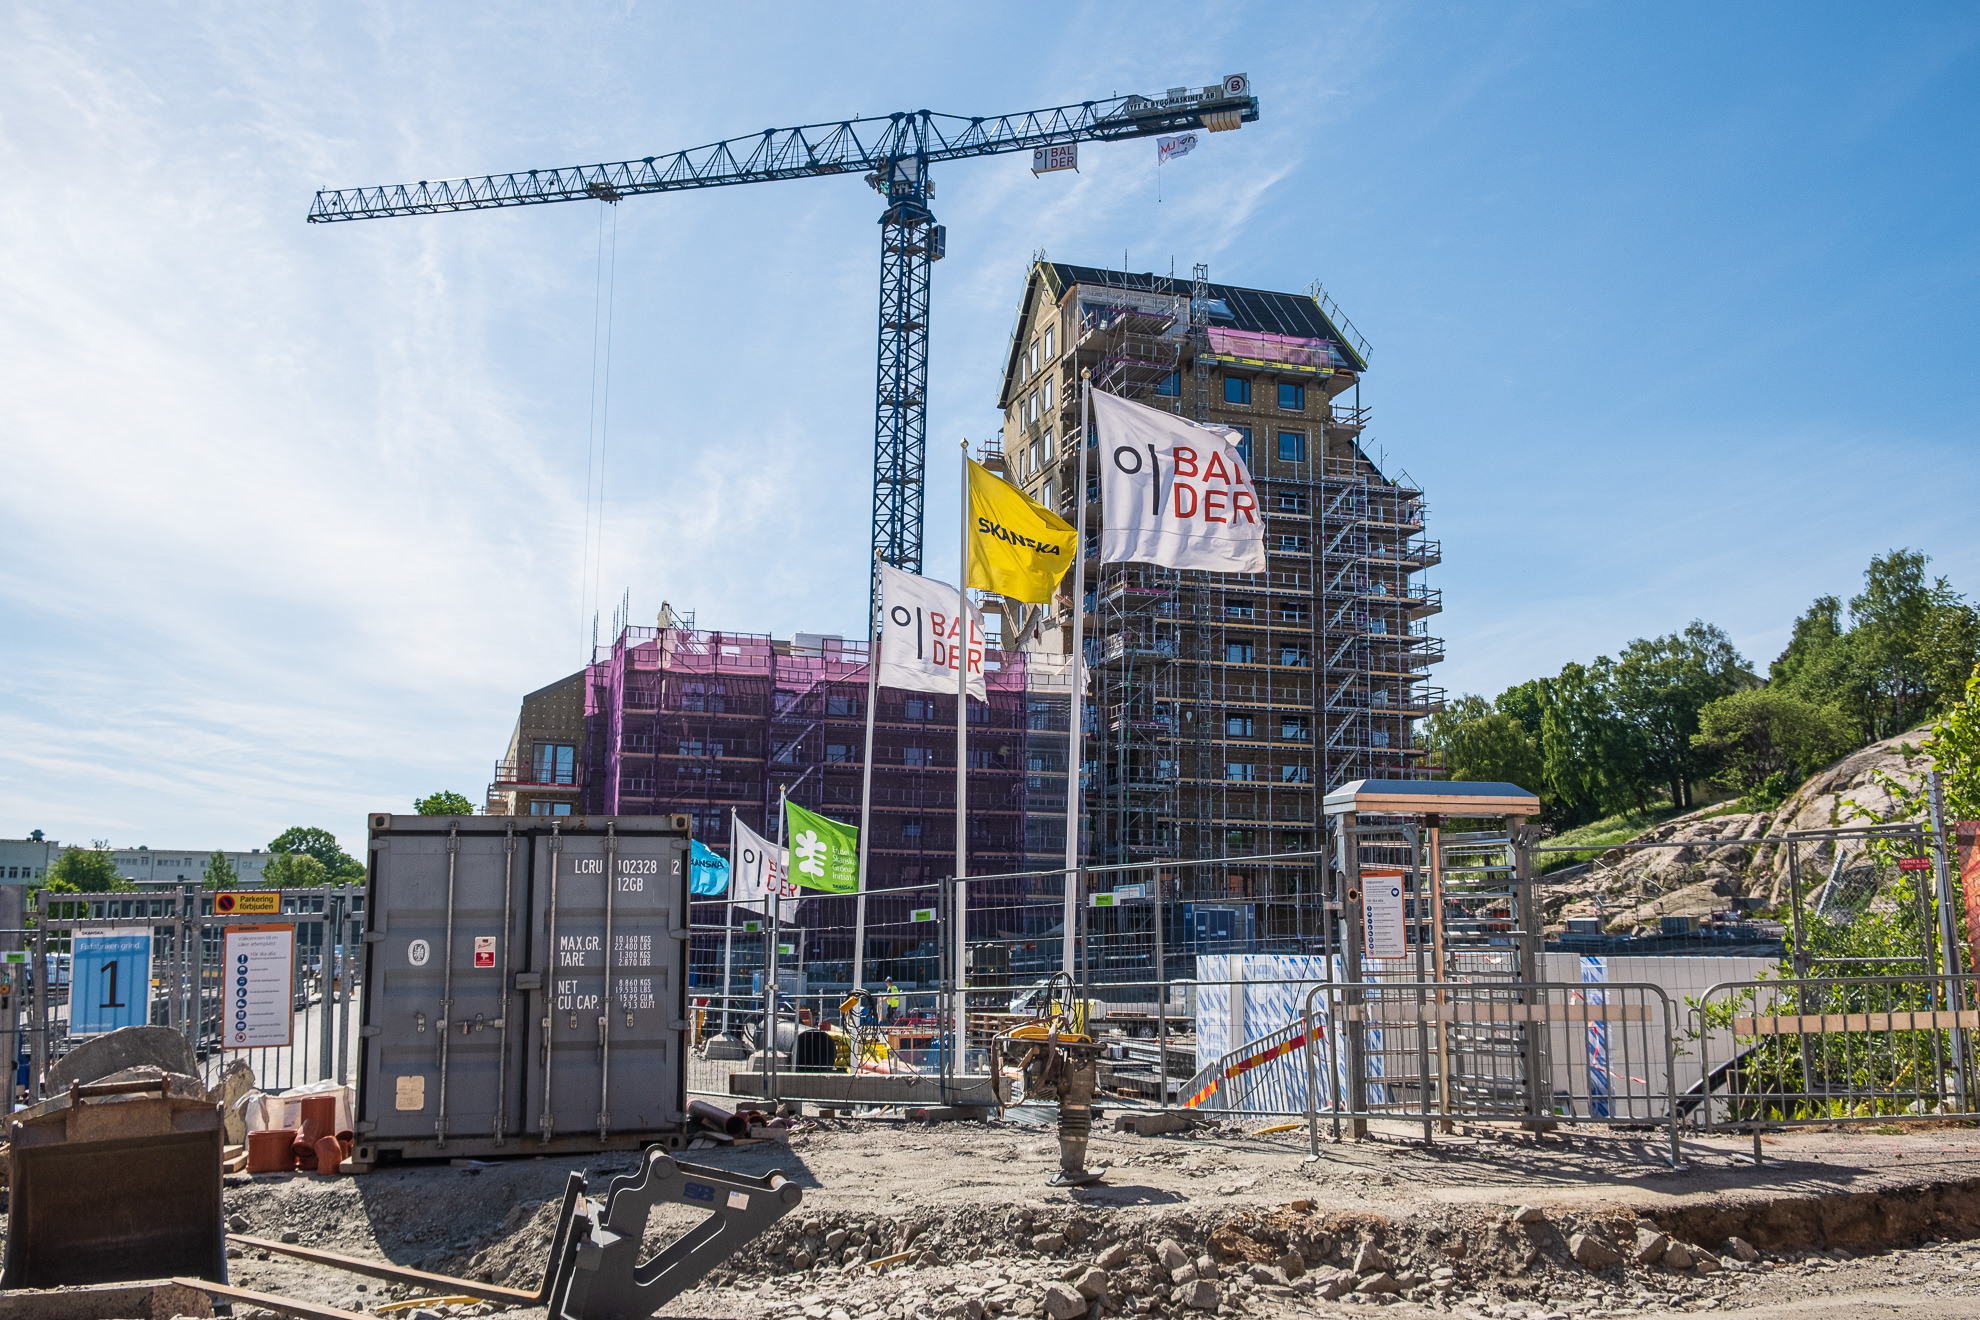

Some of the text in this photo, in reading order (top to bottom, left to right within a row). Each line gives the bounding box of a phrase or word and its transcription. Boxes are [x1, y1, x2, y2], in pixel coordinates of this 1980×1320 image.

[1126, 103, 1141, 111] LYFT
[1150, 94, 1204, 108] BYGGMASKINER
[1050, 146, 1074, 157] BAL
[1050, 156, 1074, 168] DER
[1173, 482, 1256, 524] DER
[930, 611, 982, 646] BAL
[932, 639, 982, 674] DER
[574, 859, 680, 874] LCRU 102328 2
[617, 877, 644, 892] 12GB
[239, 903, 274, 911] förbjuden
[240, 895, 274, 904] Parkering
[560, 935, 602, 951] MAX.GR.
[615, 935, 651, 943] 10.160 KGS
[560, 951, 585, 967] TARE
[619, 951, 651, 959] 1.300 KGS
[99, 960, 125, 1008] 1
[558, 980, 578, 994] NET
[557, 994, 600, 1010] CU. CAP.
